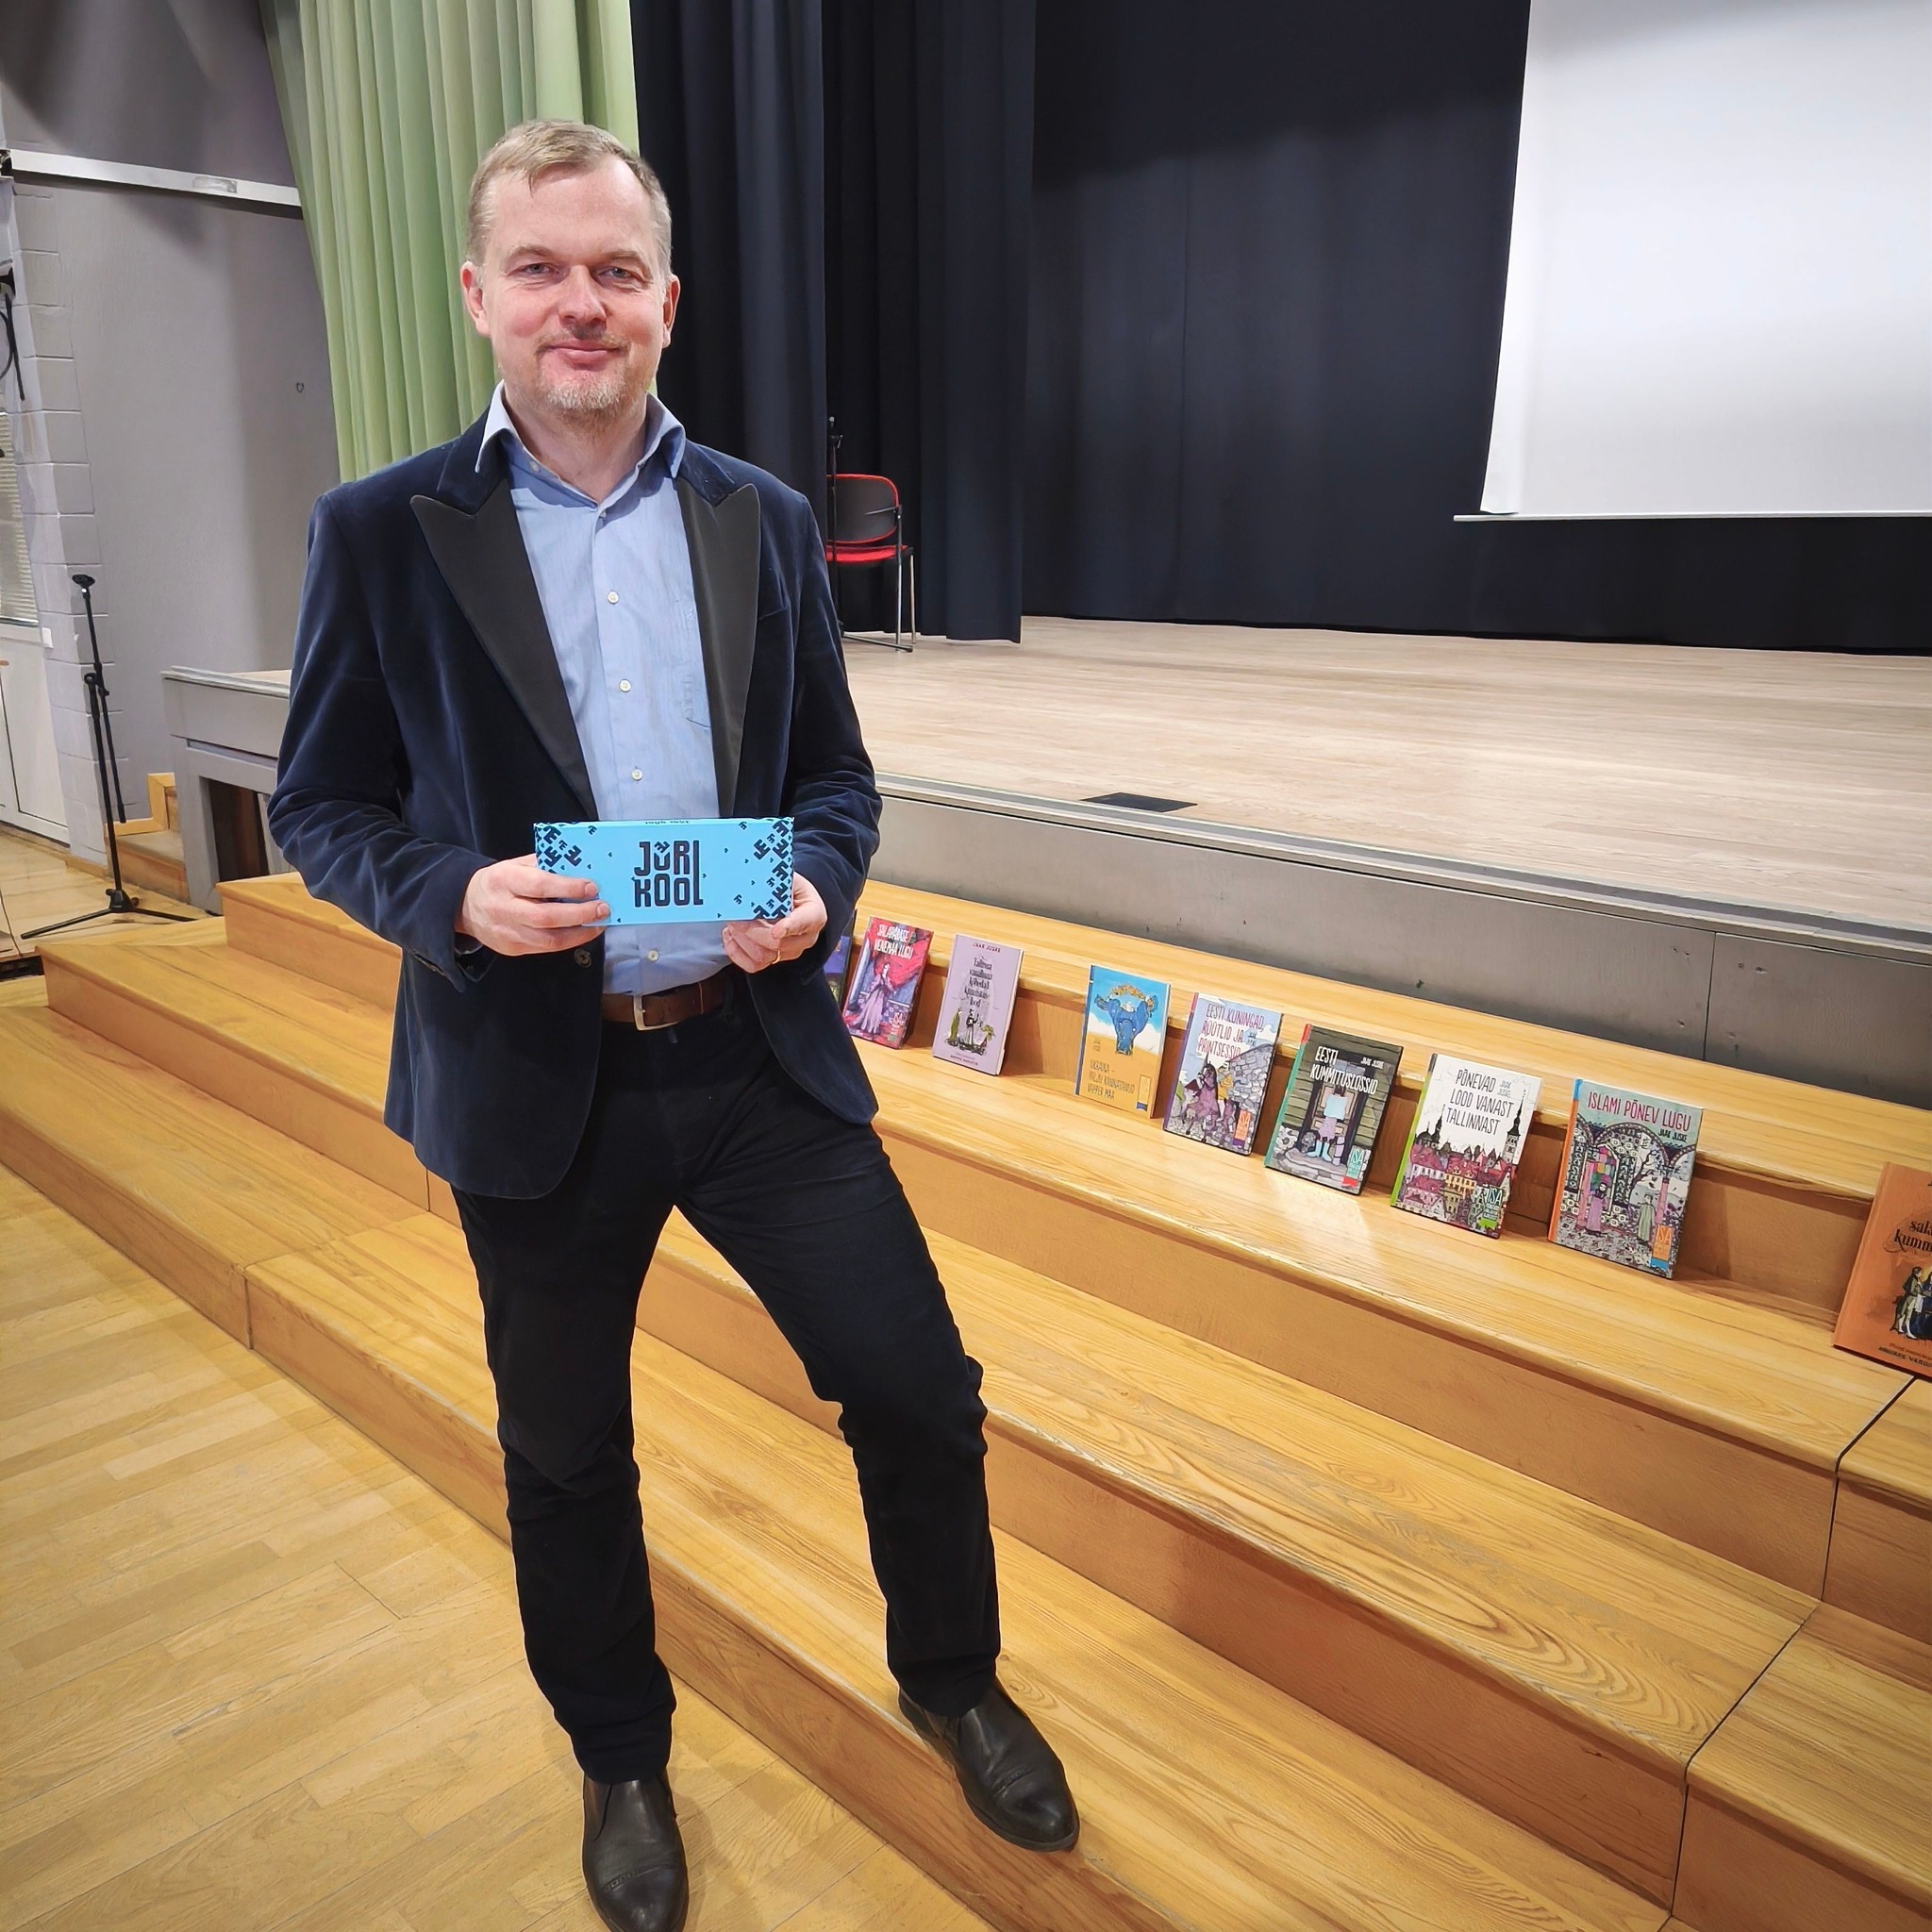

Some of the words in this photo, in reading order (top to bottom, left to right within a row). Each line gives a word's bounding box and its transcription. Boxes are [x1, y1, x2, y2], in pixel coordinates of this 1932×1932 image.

[633, 873, 704, 908] KOOL
[1206, 1003, 1225, 1021] EESTI
[1233, 1027, 1244, 1043] JA
[1315, 1046, 1339, 1066] EESTI
[1309, 1063, 1378, 1095] KUMMITUSLOSSID
[1455, 1068, 1497, 1093] PÕNEVAD
[1449, 1088, 1474, 1108] LOOD
[1475, 1094, 1515, 1119] VANAST
[1587, 1091, 1622, 1115] ISLAMI
[1624, 1099, 1660, 1124] PÕNEV
[1661, 1108, 1691, 1132] LUGU
[1445, 1107, 1502, 1136] TALLINNAST
[1487, 1187, 1503, 1208] ISA
